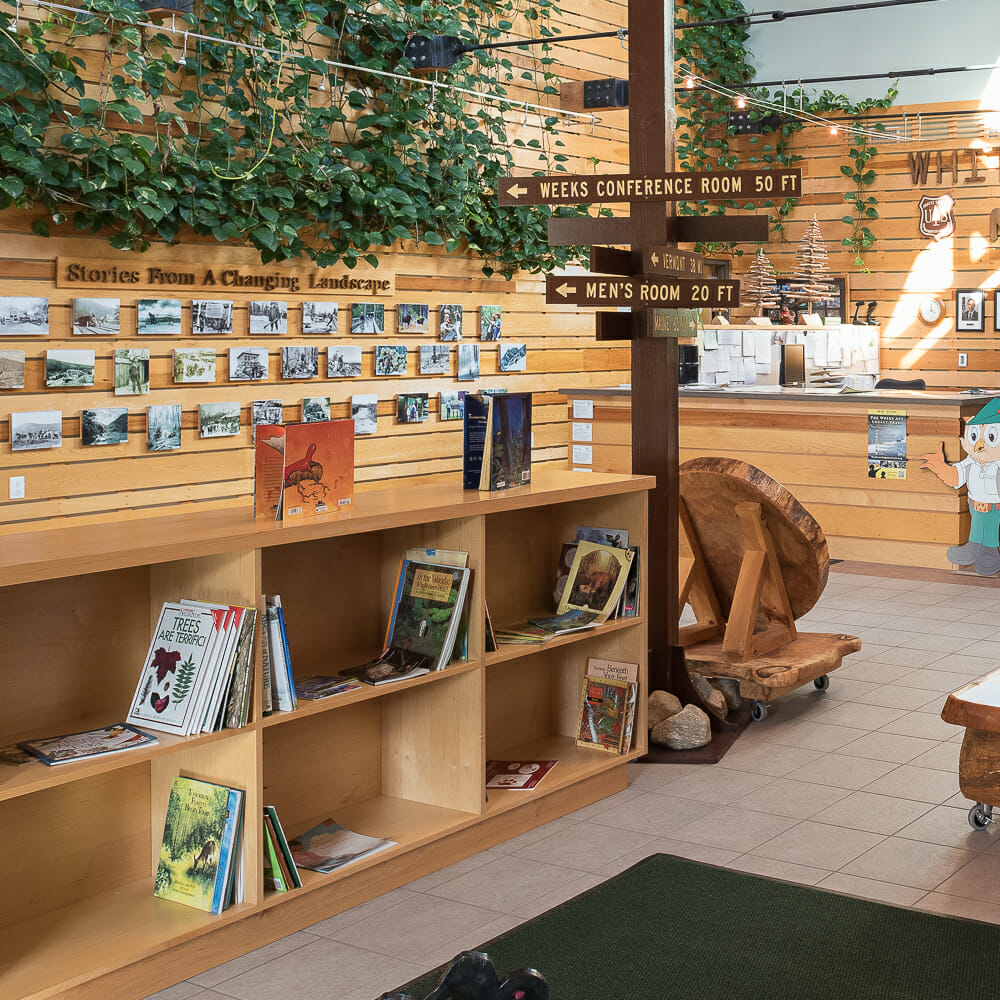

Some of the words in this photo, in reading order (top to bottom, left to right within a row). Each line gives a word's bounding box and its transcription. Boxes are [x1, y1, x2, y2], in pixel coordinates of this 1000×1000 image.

[540, 181, 588, 198] WEEKS
[596, 178, 692, 197] CONFERENCE
[701, 176, 742, 193] ROOM
[755, 175, 773, 192] 50
[781, 174, 797, 191] FT
[662, 252, 686, 272] VERMONT
[67, 263, 140, 284] Stories
[148, 267, 196, 285] From
[203, 269, 218, 286] A
[220, 269, 300, 292] Changing
[308, 272, 391, 295] Landscape
[586, 282, 632, 299] MEN'S
[640, 284, 680, 301] ROOM
[691, 285, 709, 301] 20
[718, 285, 734, 302] FT
[654, 314, 670, 331] MAINE
[171, 616, 202, 634] TREES
[158, 630, 174, 642] ARE
[175, 631, 207, 647] TERRIFIC!
[263, 655, 271, 690] NATURE
